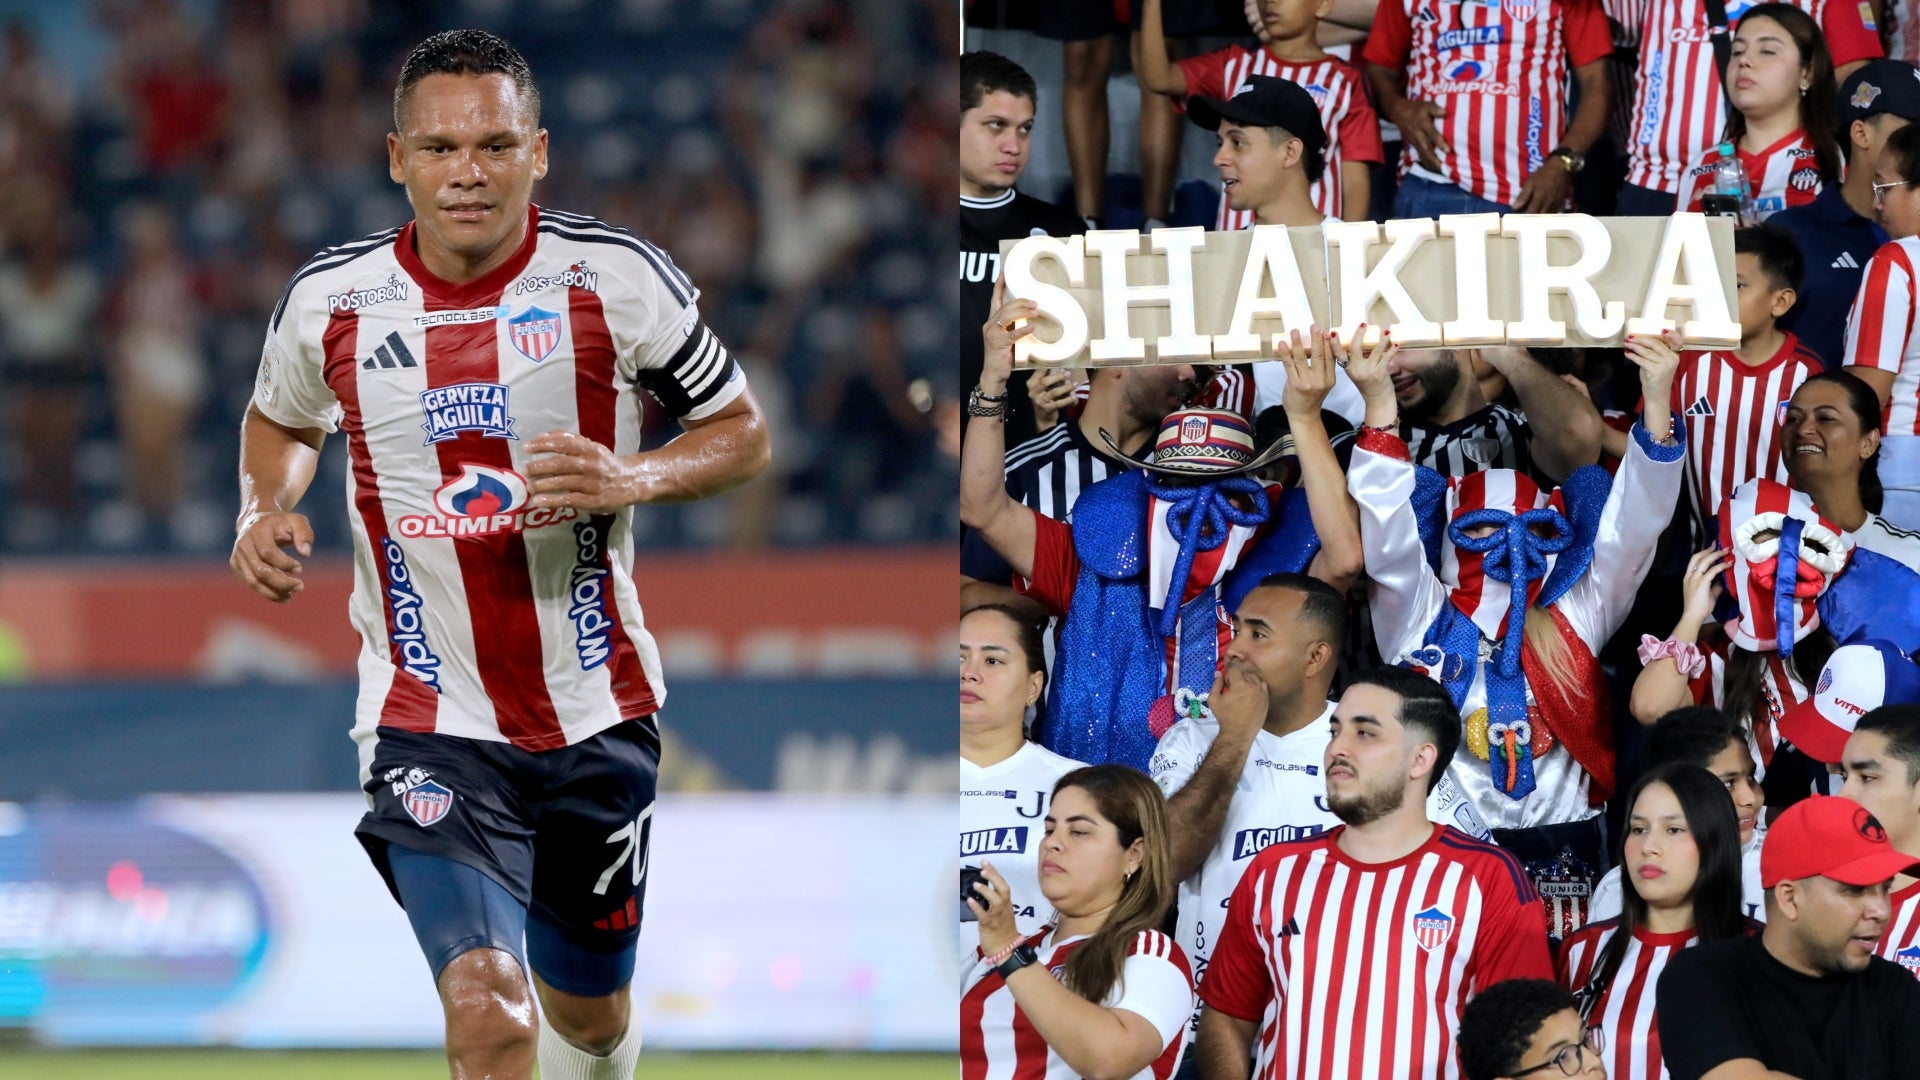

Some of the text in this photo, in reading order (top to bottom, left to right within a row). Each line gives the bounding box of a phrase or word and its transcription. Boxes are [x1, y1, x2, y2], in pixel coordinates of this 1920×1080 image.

[1436, 26, 1500, 50] AGUILA
[1004, 212, 1742, 365] SHAKIRA
[517, 324, 554, 335] JUNIOR
[431, 404, 503, 433] AGUILA
[399, 507, 576, 537] OLIMPICA
[571, 525, 612, 669] wplay.co
[411, 794, 443, 804] JUNIOR
[1016, 791, 1047, 819] J
[593, 800, 656, 896] 70
[960, 828, 1020, 855] UILA
[1543, 884, 1584, 893] JUNIOR
[1419, 921, 1446, 930] JUNIOR
